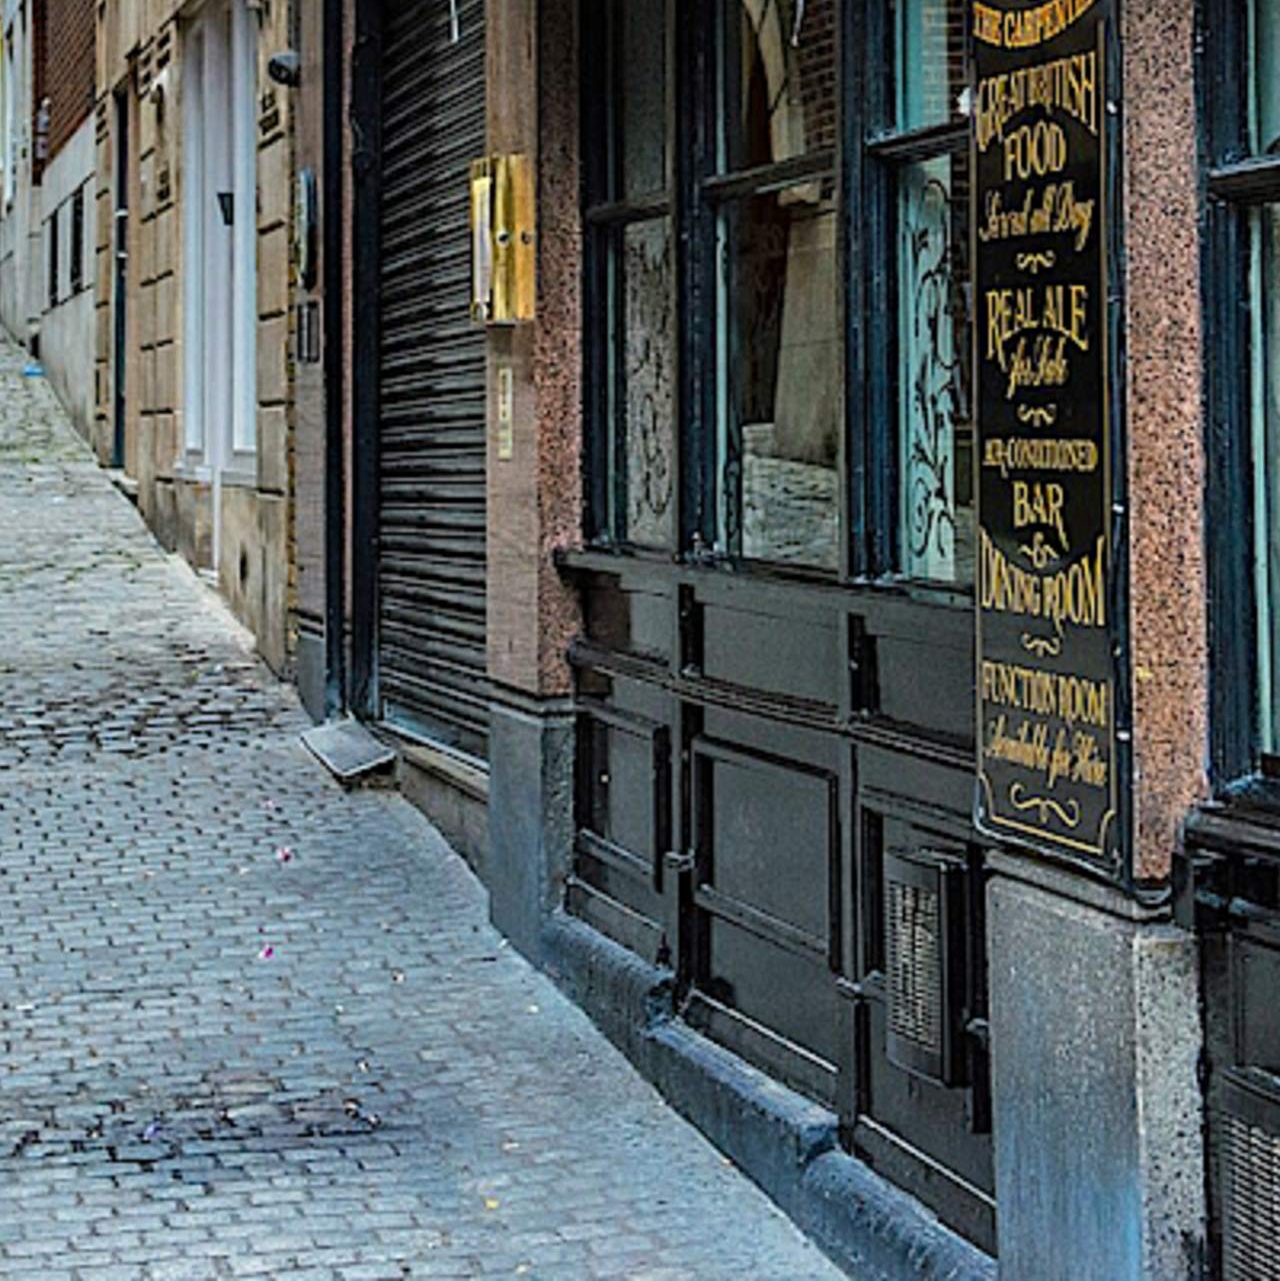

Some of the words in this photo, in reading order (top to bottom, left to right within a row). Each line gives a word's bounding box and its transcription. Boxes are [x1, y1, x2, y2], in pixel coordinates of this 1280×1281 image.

[972, 0, 1002, 47] THE
[975, 68, 1026, 153] GREAT
[1026, 50, 1099, 137] BRITISH
[1003, 119, 1067, 182] FOOD
[985, 287, 1039, 373] REAL
[1042, 284, 1089, 352] ALE
[1012, 479, 1070, 553] BAR
[978, 523, 1042, 617] DINING
[1042, 534, 1106, 639] ROOM
[982, 660, 1057, 716] FUNCTION
[1057, 674, 1107, 729] ROOM
